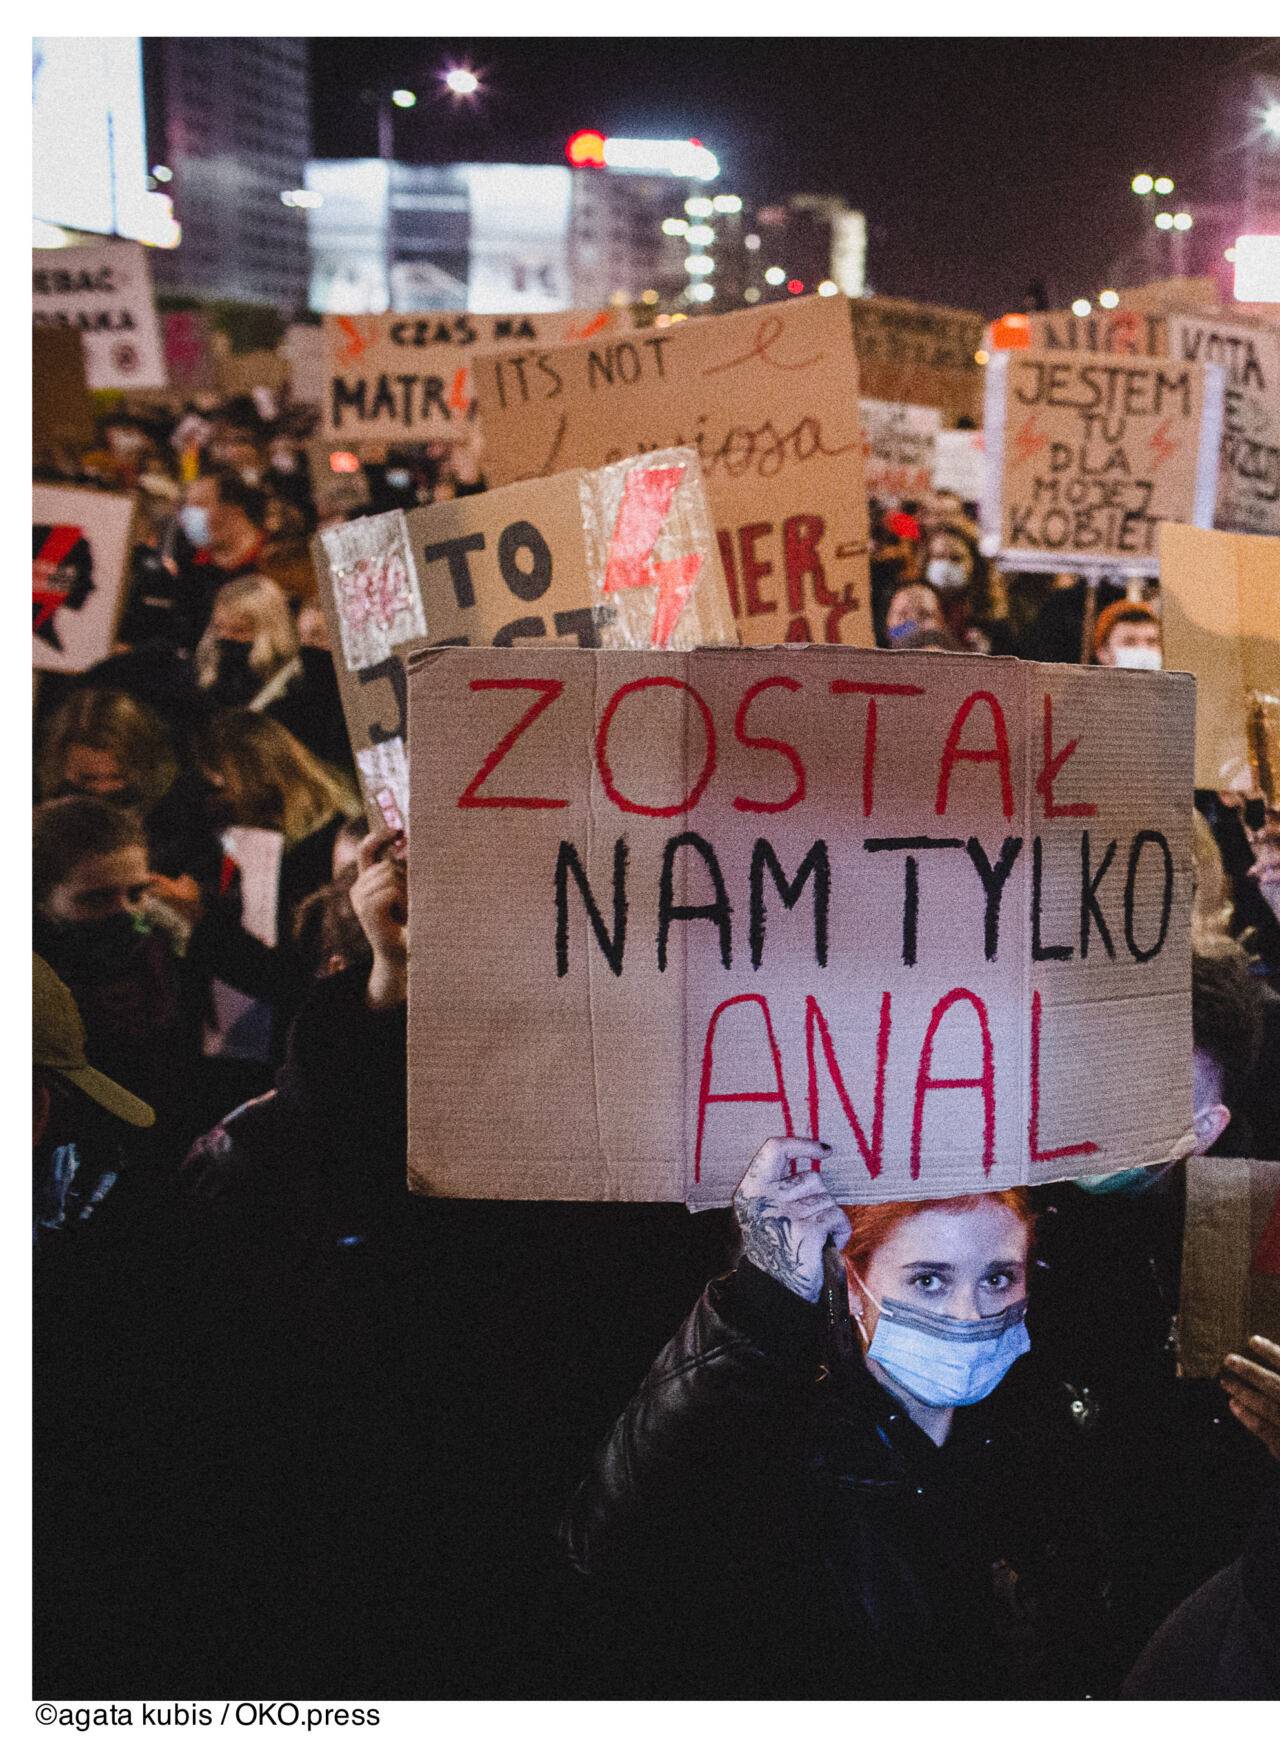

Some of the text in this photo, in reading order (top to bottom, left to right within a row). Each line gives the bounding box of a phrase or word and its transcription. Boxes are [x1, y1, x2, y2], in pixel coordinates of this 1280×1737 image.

[390, 315, 477, 347] CZAS
[587, 336, 673, 392] NOT
[1012, 360, 1191, 419] JESTEM
[1079, 411, 1129, 445] TU
[1049, 443, 1132, 476] DLA
[1033, 478, 1153, 518] MOJEJ
[1008, 506, 1186, 554] KOBIET
[424, 519, 554, 610] TO
[457, 674, 1098, 819] ZOSTAŁ
[553, 829, 1176, 977] NAM TYLKO
[694, 987, 1102, 1185] ANAL
